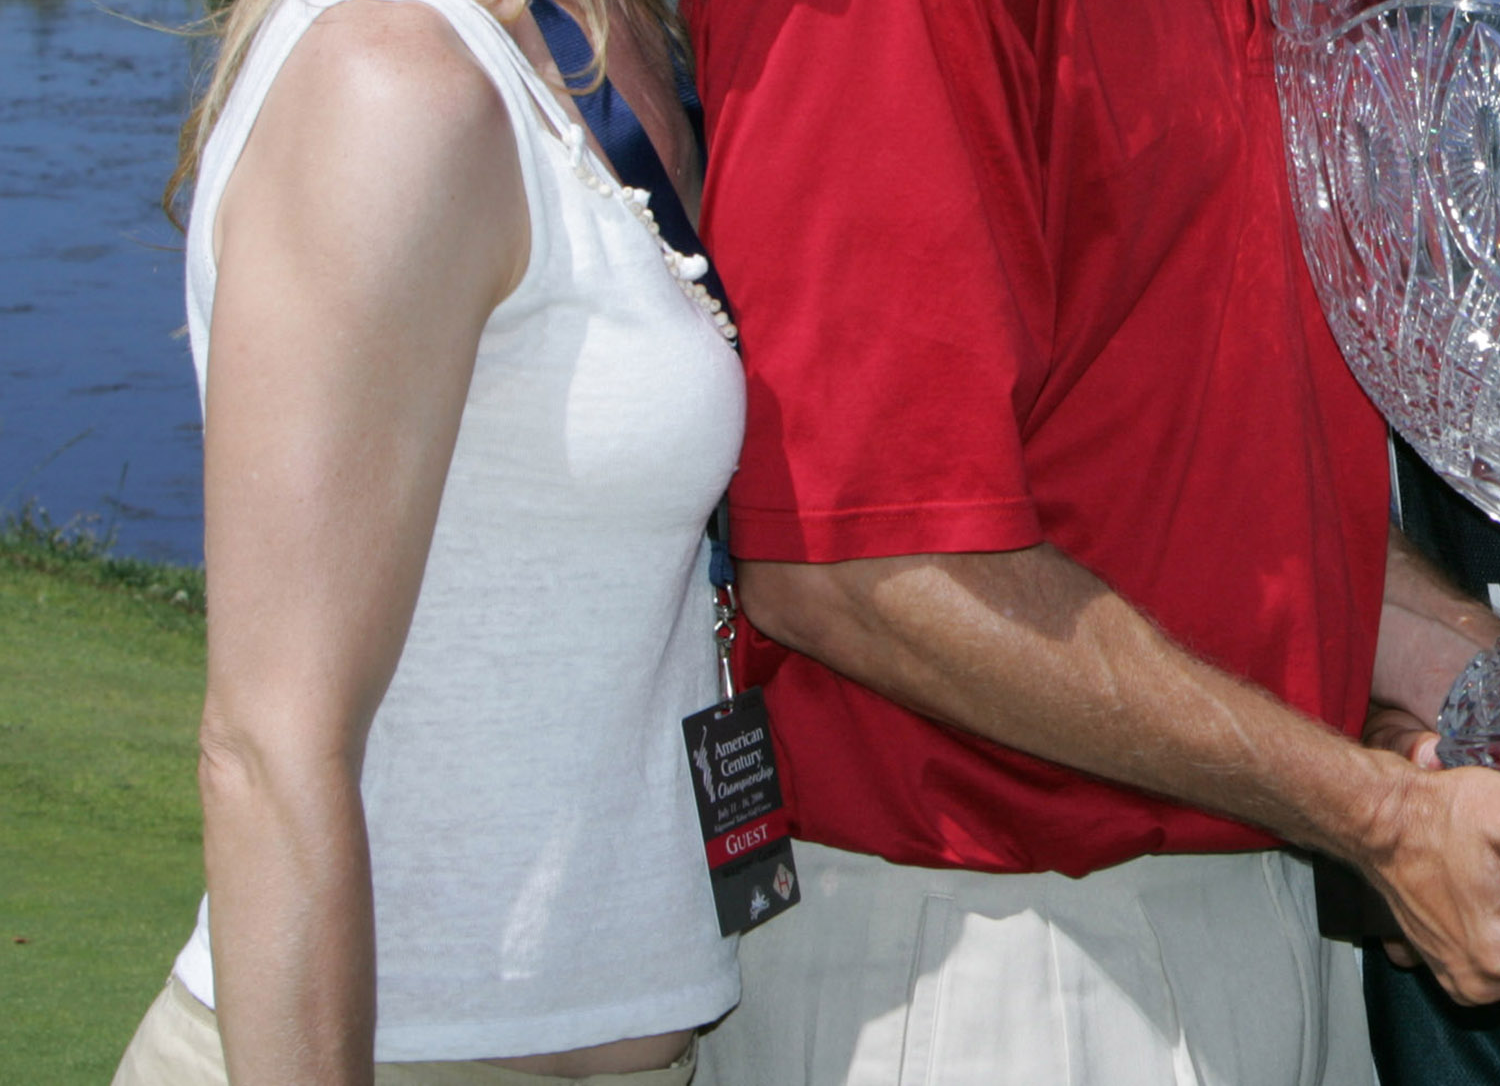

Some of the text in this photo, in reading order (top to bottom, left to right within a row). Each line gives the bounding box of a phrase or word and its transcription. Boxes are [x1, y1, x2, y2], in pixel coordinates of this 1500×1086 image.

[715, 727, 764, 760] American
[720, 749, 762, 777] Century
[726, 823, 768, 855] GUEST
